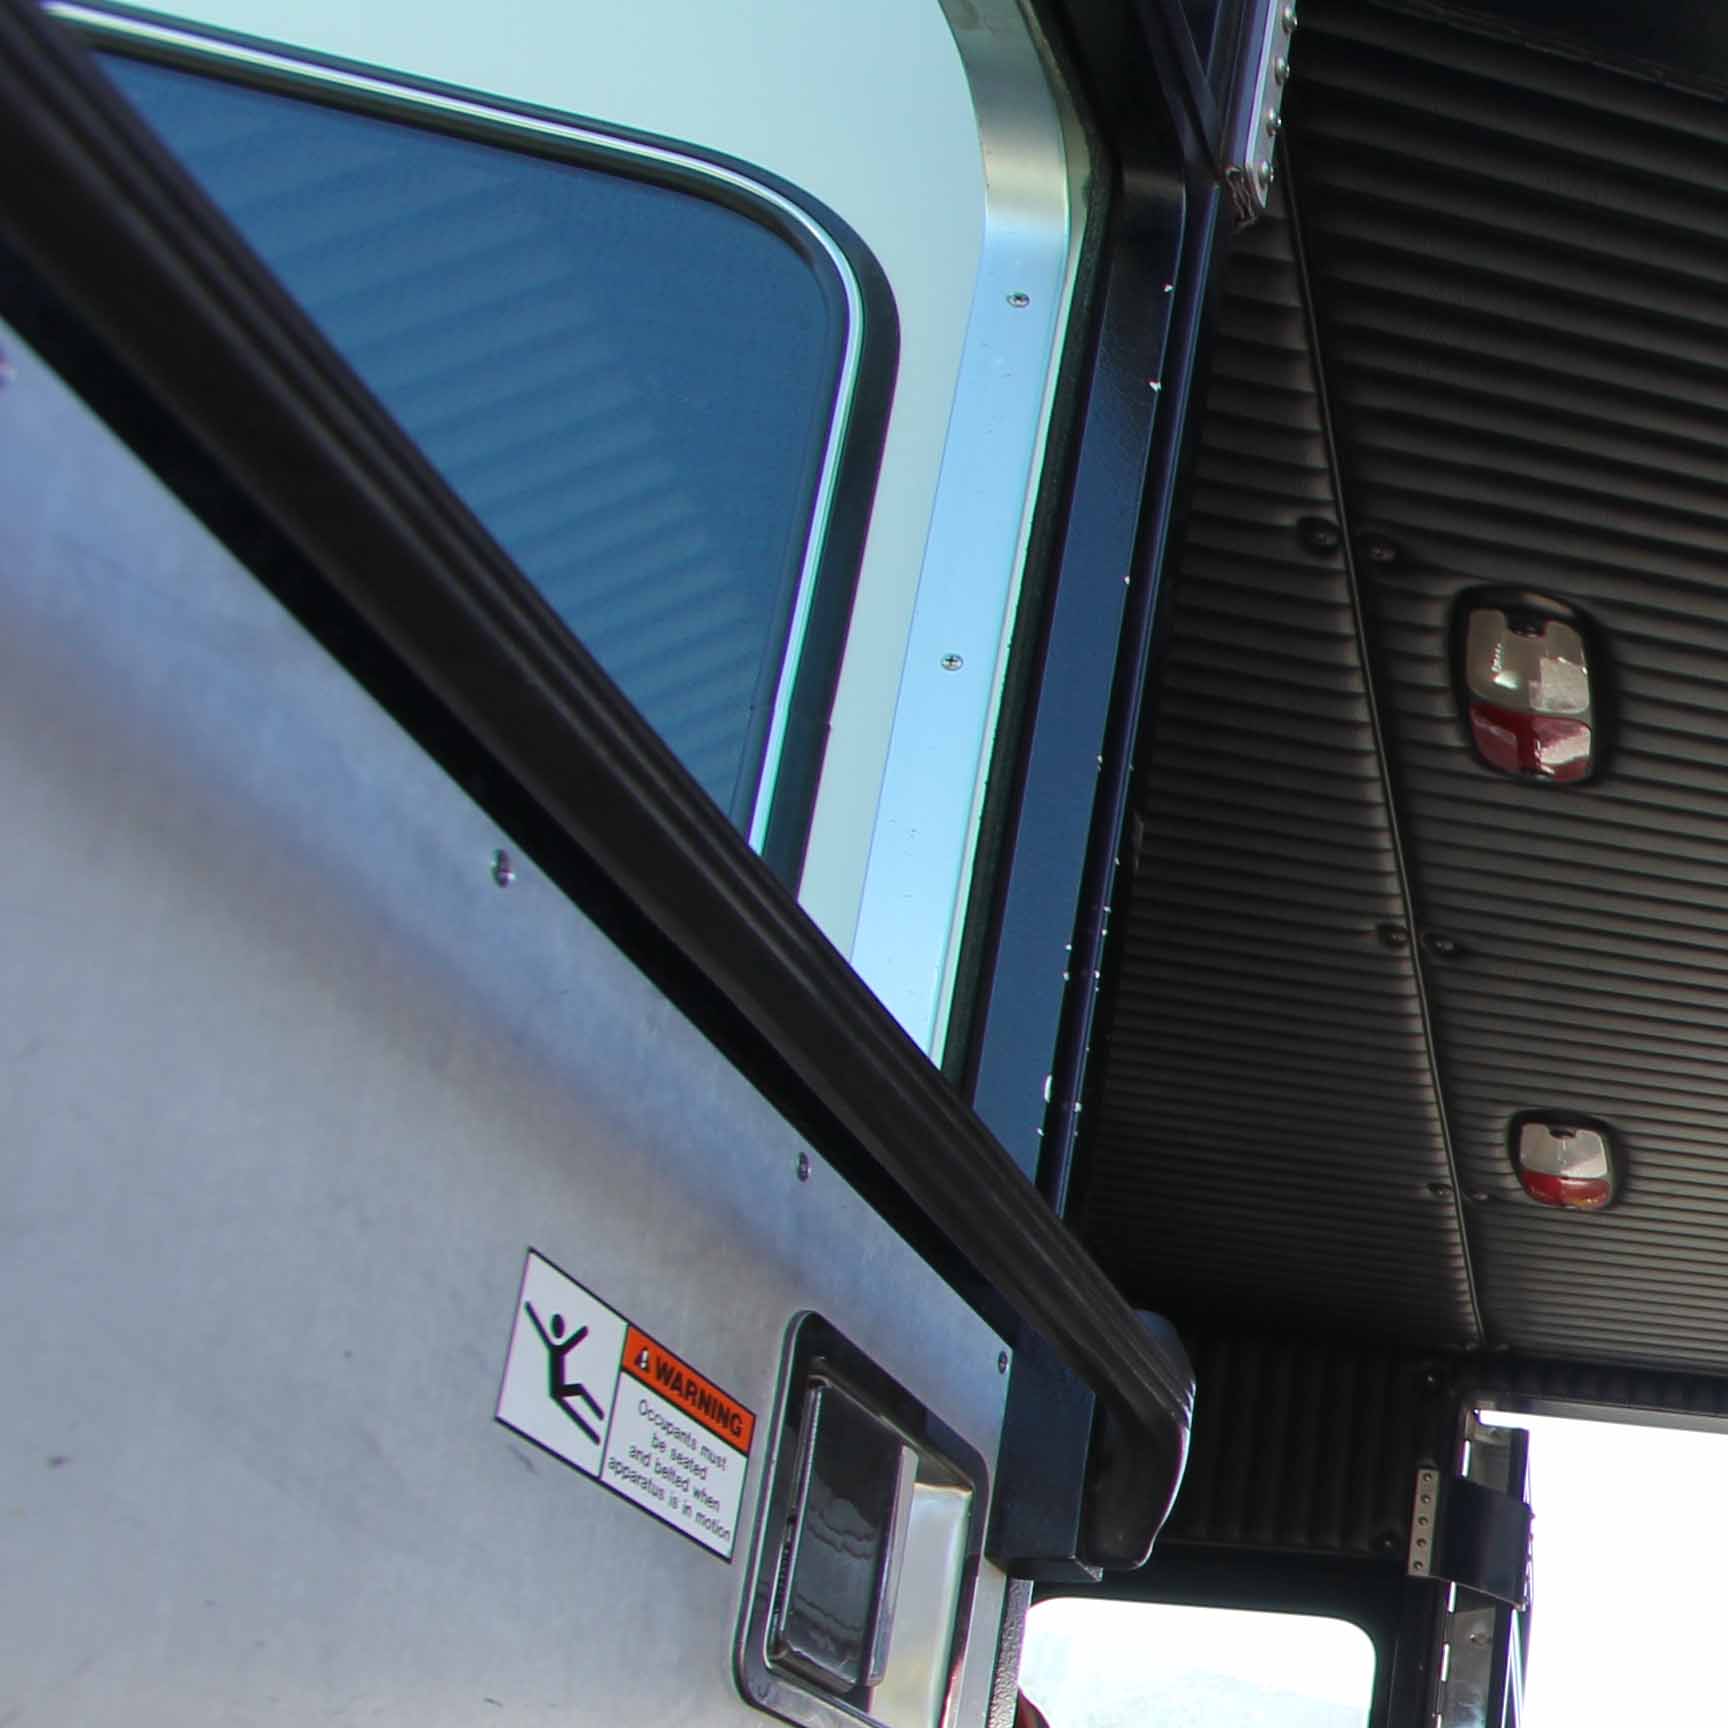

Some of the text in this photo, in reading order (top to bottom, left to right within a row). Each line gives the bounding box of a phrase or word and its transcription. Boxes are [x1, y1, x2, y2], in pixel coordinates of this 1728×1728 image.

[654, 1355, 742, 1438] WARNING
[638, 1399, 728, 1472] Occupants must
[652, 1432, 707, 1481] be seated
[607, 1456, 731, 1542] apparatus is in motion
[629, 1444, 720, 1514] and belted when
